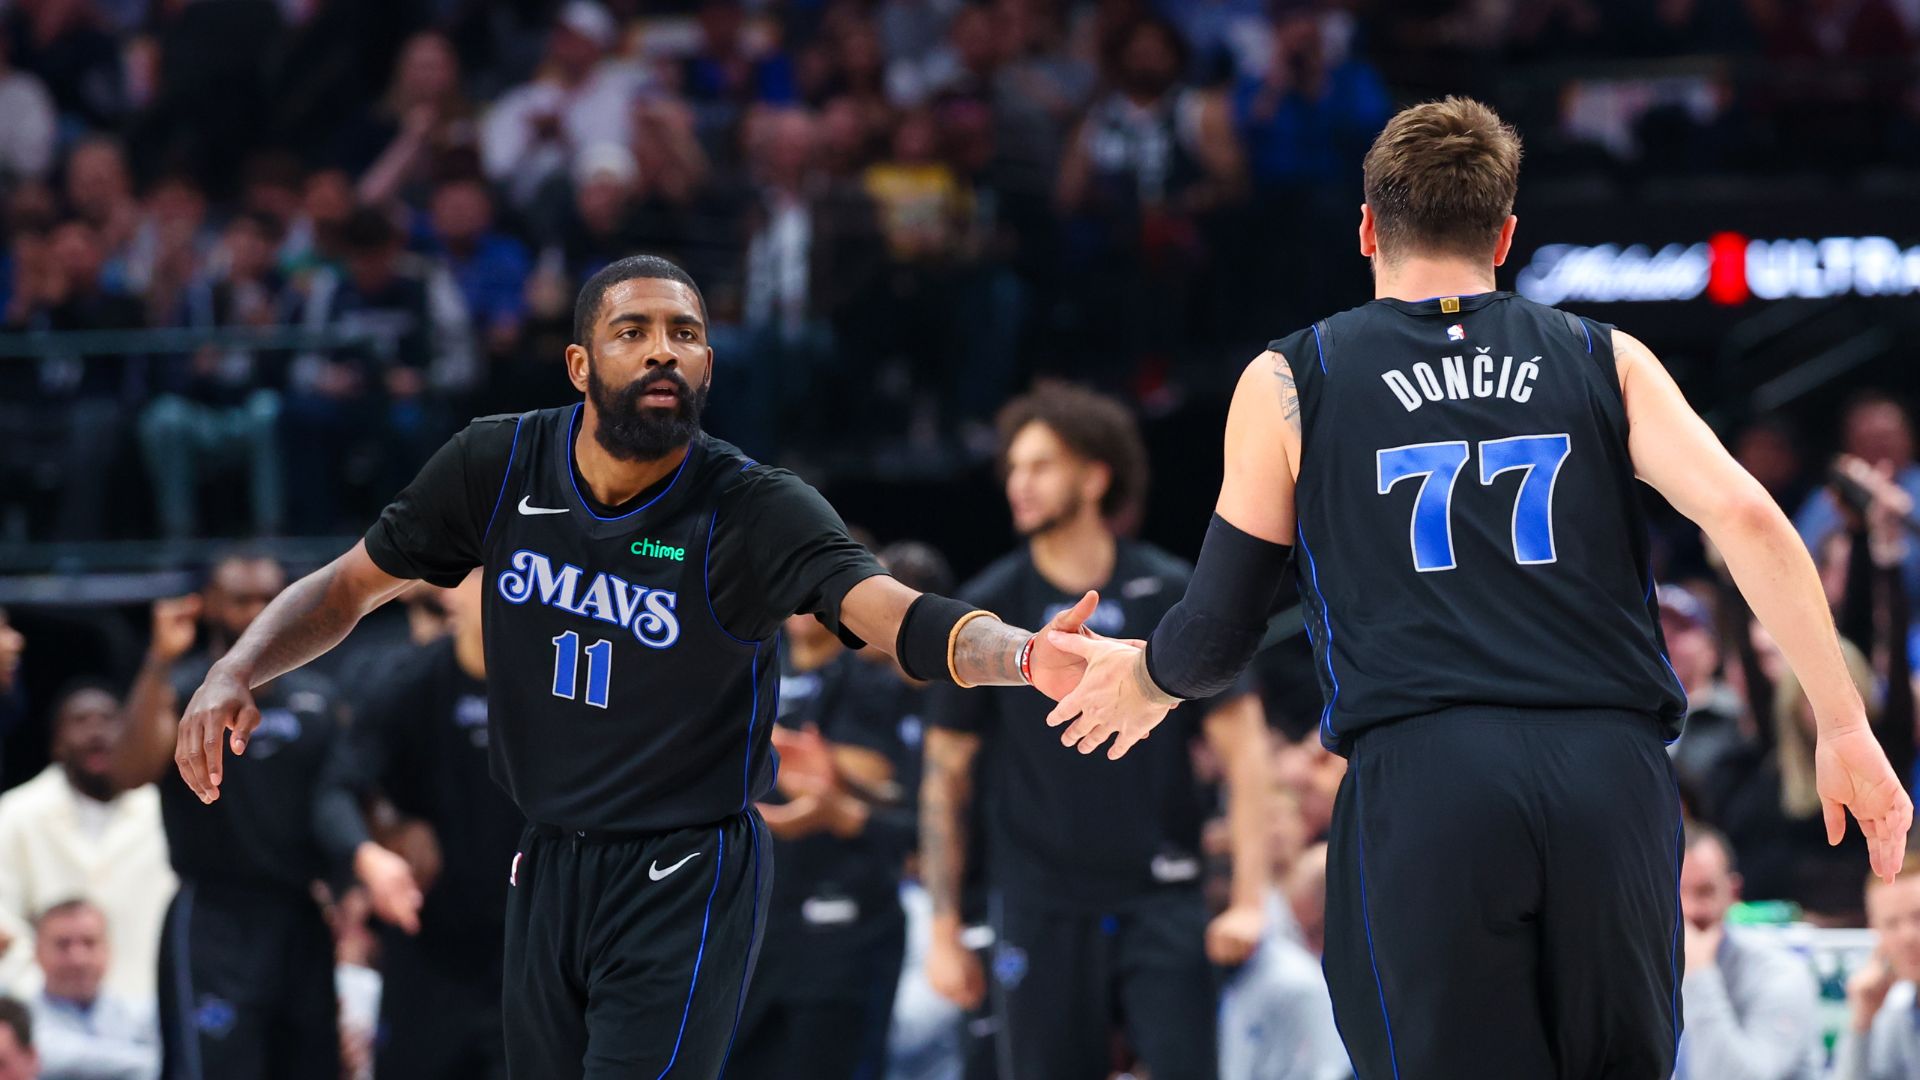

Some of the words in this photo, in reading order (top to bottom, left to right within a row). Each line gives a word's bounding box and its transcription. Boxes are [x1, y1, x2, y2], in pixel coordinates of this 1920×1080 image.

[1381, 346, 1542, 412] DONČIĆ
[1376, 433, 1571, 572] 77
[631, 538, 685, 561] chime
[498, 549, 680, 649] MAVS
[552, 630, 612, 709] 11
